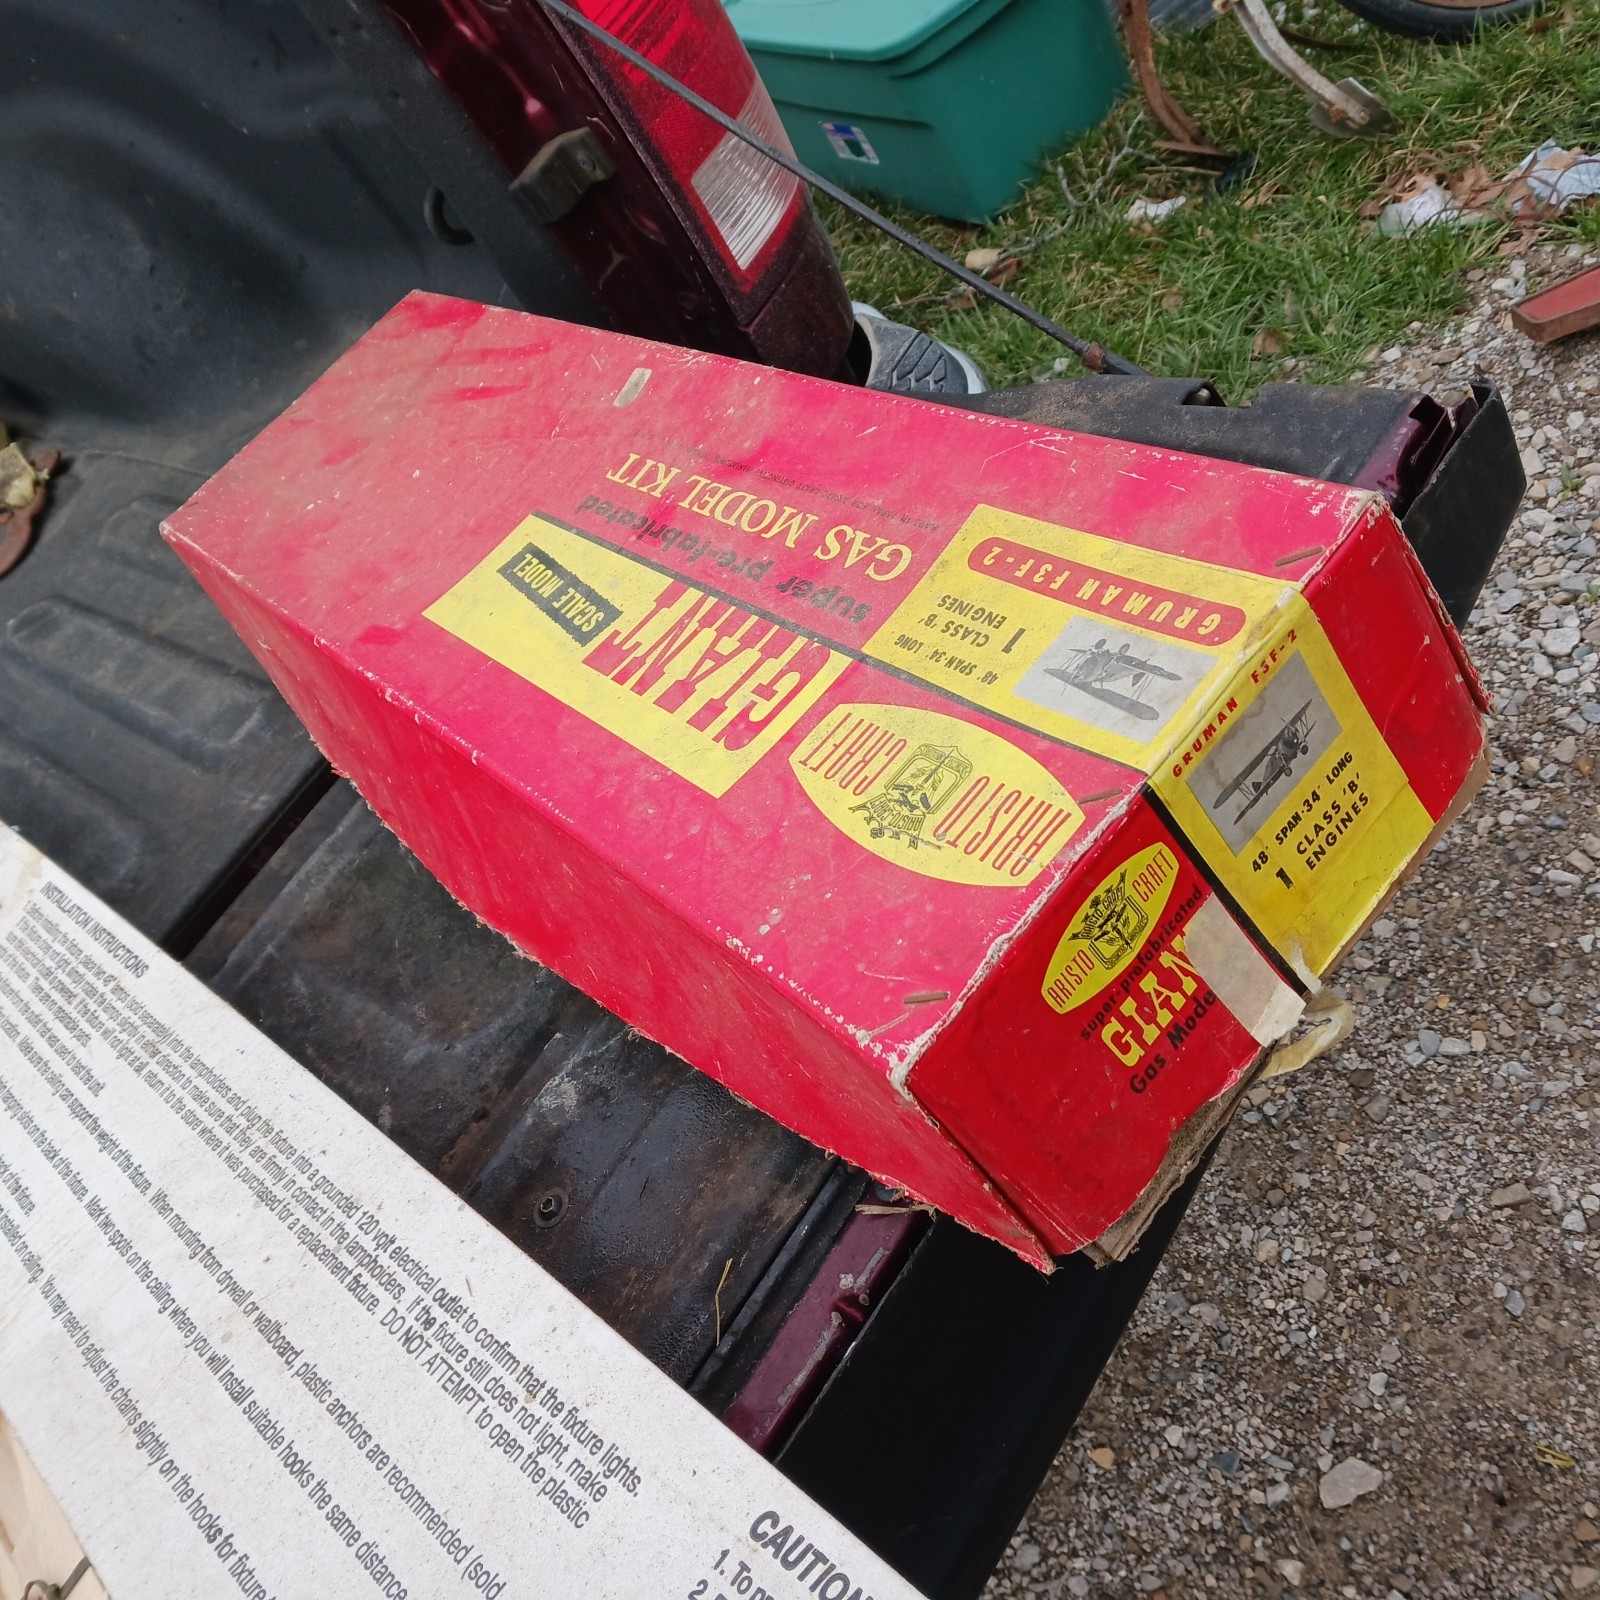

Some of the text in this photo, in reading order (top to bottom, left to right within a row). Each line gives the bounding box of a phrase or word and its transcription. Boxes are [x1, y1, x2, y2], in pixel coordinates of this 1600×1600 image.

[605, 452, 913, 582] GAS MODEL KIT
[512, 553, 605, 632] SCALE MODEL
[775, 575, 873, 625] super
[983, 546, 1222, 635] GRUMAN F3F-2
[937, 594, 1007, 630] ENGINES
[894, 634, 924, 654] LONG
[940, 620, 990, 647] CLASS
[581, 579, 831, 752] GIANT
[1172, 697, 1239, 778] GRUMAN
[1325, 751, 1353, 785] LONG
[799, 712, 1072, 877] ARISTO CRAFT
[1296, 800, 1341, 855] CLASS
[1305, 792, 1369, 871] ENGINES
[40, 882, 94, 929] INSTALLATION
[86, 922, 149, 978] INSTRUCTIONS
[1047, 849, 1174, 1009] ARISTO CRAFT
[1101, 930, 1198, 1067] GIAN
[189, 1055, 232, 1098] lampholders
[1129, 1053, 1166, 1095] Gas
[187, 1085, 210, 1107] make
[204, 1102, 225, 1122] sure
[226, 1093, 249, 1111] and
[219, 1114, 241, 1136] that
[236, 1106, 262, 1130] plug
[255, 1119, 274, 1138] the
[197, 1125, 223, 1151] where
[217, 1143, 231, 1158] it
[233, 1127, 257, 1153] they
[249, 1146, 267, 1163] are
[268, 1130, 297, 1160] fixture
[223, 1151, 243, 1172] was
[261, 1155, 288, 1186] firmly
[291, 1151, 313, 1174] into
[307, 1169, 319, 1182] a
[234, 1167, 286, 1212] purchased
[282, 1174, 296, 1192] in
[311, 1176, 363, 1219] grounded
[276, 1202, 294, 1223] for
[291, 1187, 329, 1222] contact
[320, 1211, 335, 1230] in
[287, 1218, 300, 1231] a
[329, 1221, 349, 1245] the
[355, 1211, 379, 1235] 120
[294, 1224, 354, 1284] replacement
[372, 1228, 397, 1253] volt
[40, 1274, 57, 1299] You
[389, 1246, 441, 1294] electrical
[49, 1294, 69, 1319] may
[380, 1307, 406, 1335] DO
[406, 1295, 425, 1314] If
[414, 1305, 437, 1331] the
[432, 1288, 469, 1323] outlet
[60, 1311, 87, 1338] need
[75, 1330, 90, 1348] to
[462, 1312, 478, 1333] to
[397, 1325, 432, 1359] NOT
[431, 1321, 469, 1363] fixture
[475, 1328, 520, 1375] confirm
[81, 1343, 111, 1377] adjust
[118, 1154, 134, 1173] the
[149, 1188, 174, 1219] When
[167, 1214, 206, 1260] mounting
[198, 1246, 222, 1276] from
[216, 1269, 253, 1307] drywall
[243, 1301, 260, 1317] or
[291, 1362, 332, 1403] plastic
[326, 1398, 372, 1450] anchors
[366, 1444, 390, 1471] are
[384, 1464, 474, 1565] recommended
[461, 1555, 507, 1600] (sold
[464, 1357, 493, 1384] still
[100, 1368, 119, 1392] the
[421, 1353, 485, 1414] ATTEMPT
[484, 1376, 527, 1413] does
[516, 1365, 547, 1400] that
[84, 1195, 107, 1222] Mark
[97, 1213, 115, 1235] two
[108, 1230, 133, 1257] spots
[126, 1252, 142, 1268] on
[135, 1260, 153, 1282] the
[146, 1277, 176, 1314] ceiling
[168, 1305, 197, 1338] where
[184, 1332, 212, 1358] you
[205, 1351, 230, 1375] will
[218, 1365, 254, 1406] install
[242, 1400, 285, 1450] suitable
[277, 1440, 315, 1488] hooks
[308, 1479, 332, 1510] the
[325, 1504, 361, 1547] same
[355, 1541, 410, 1600] distance
[111, 1388, 142, 1426] chains
[539, 1387, 565, 1418] the
[475, 1406, 493, 1429] to
[513, 1401, 542, 1435] not
[560, 1407, 604, 1455] fixture
[133, 1420, 169, 1466] slightly
[489, 1424, 524, 1462] open
[159, 1459, 179, 1482] on
[520, 1451, 546, 1484] the
[566, 1458, 608, 1502] make
[172, 1473, 195, 1503] the
[537, 1476, 589, 1528] plastic
[186, 1493, 223, 1544] hooks
[214, 1533, 238, 1563] for
[228, 1554, 268, 1600] fixture
[713, 1549, 730, 1576] 1.
[730, 1560, 753, 1595] To
